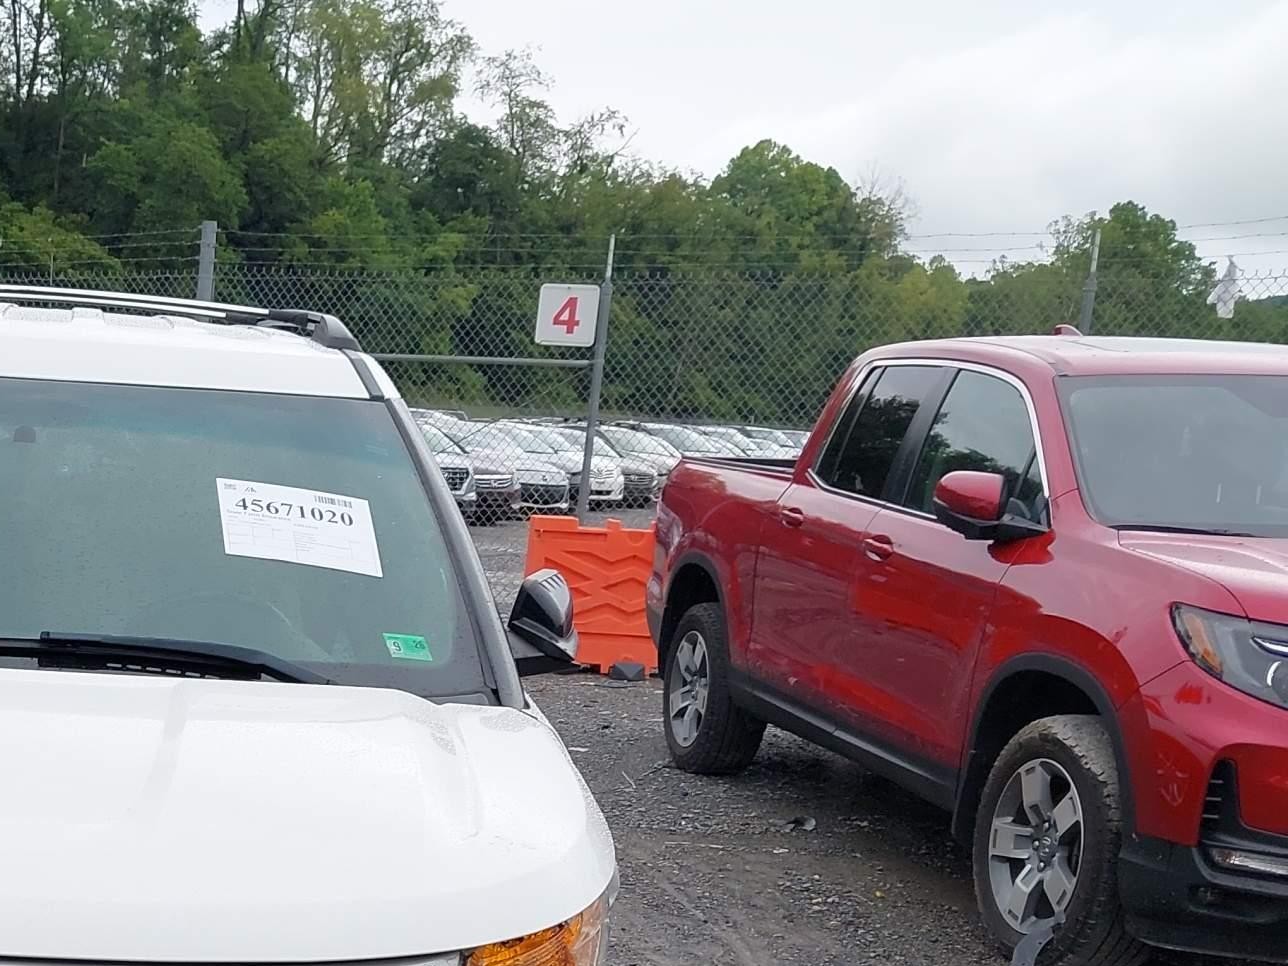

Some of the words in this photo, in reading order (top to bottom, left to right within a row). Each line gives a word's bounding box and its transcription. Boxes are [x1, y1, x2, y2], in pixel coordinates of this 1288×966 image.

[552, 296, 580, 334] 4
[234, 497, 354, 527] 45671020
[392, 640, 402, 652] 9
